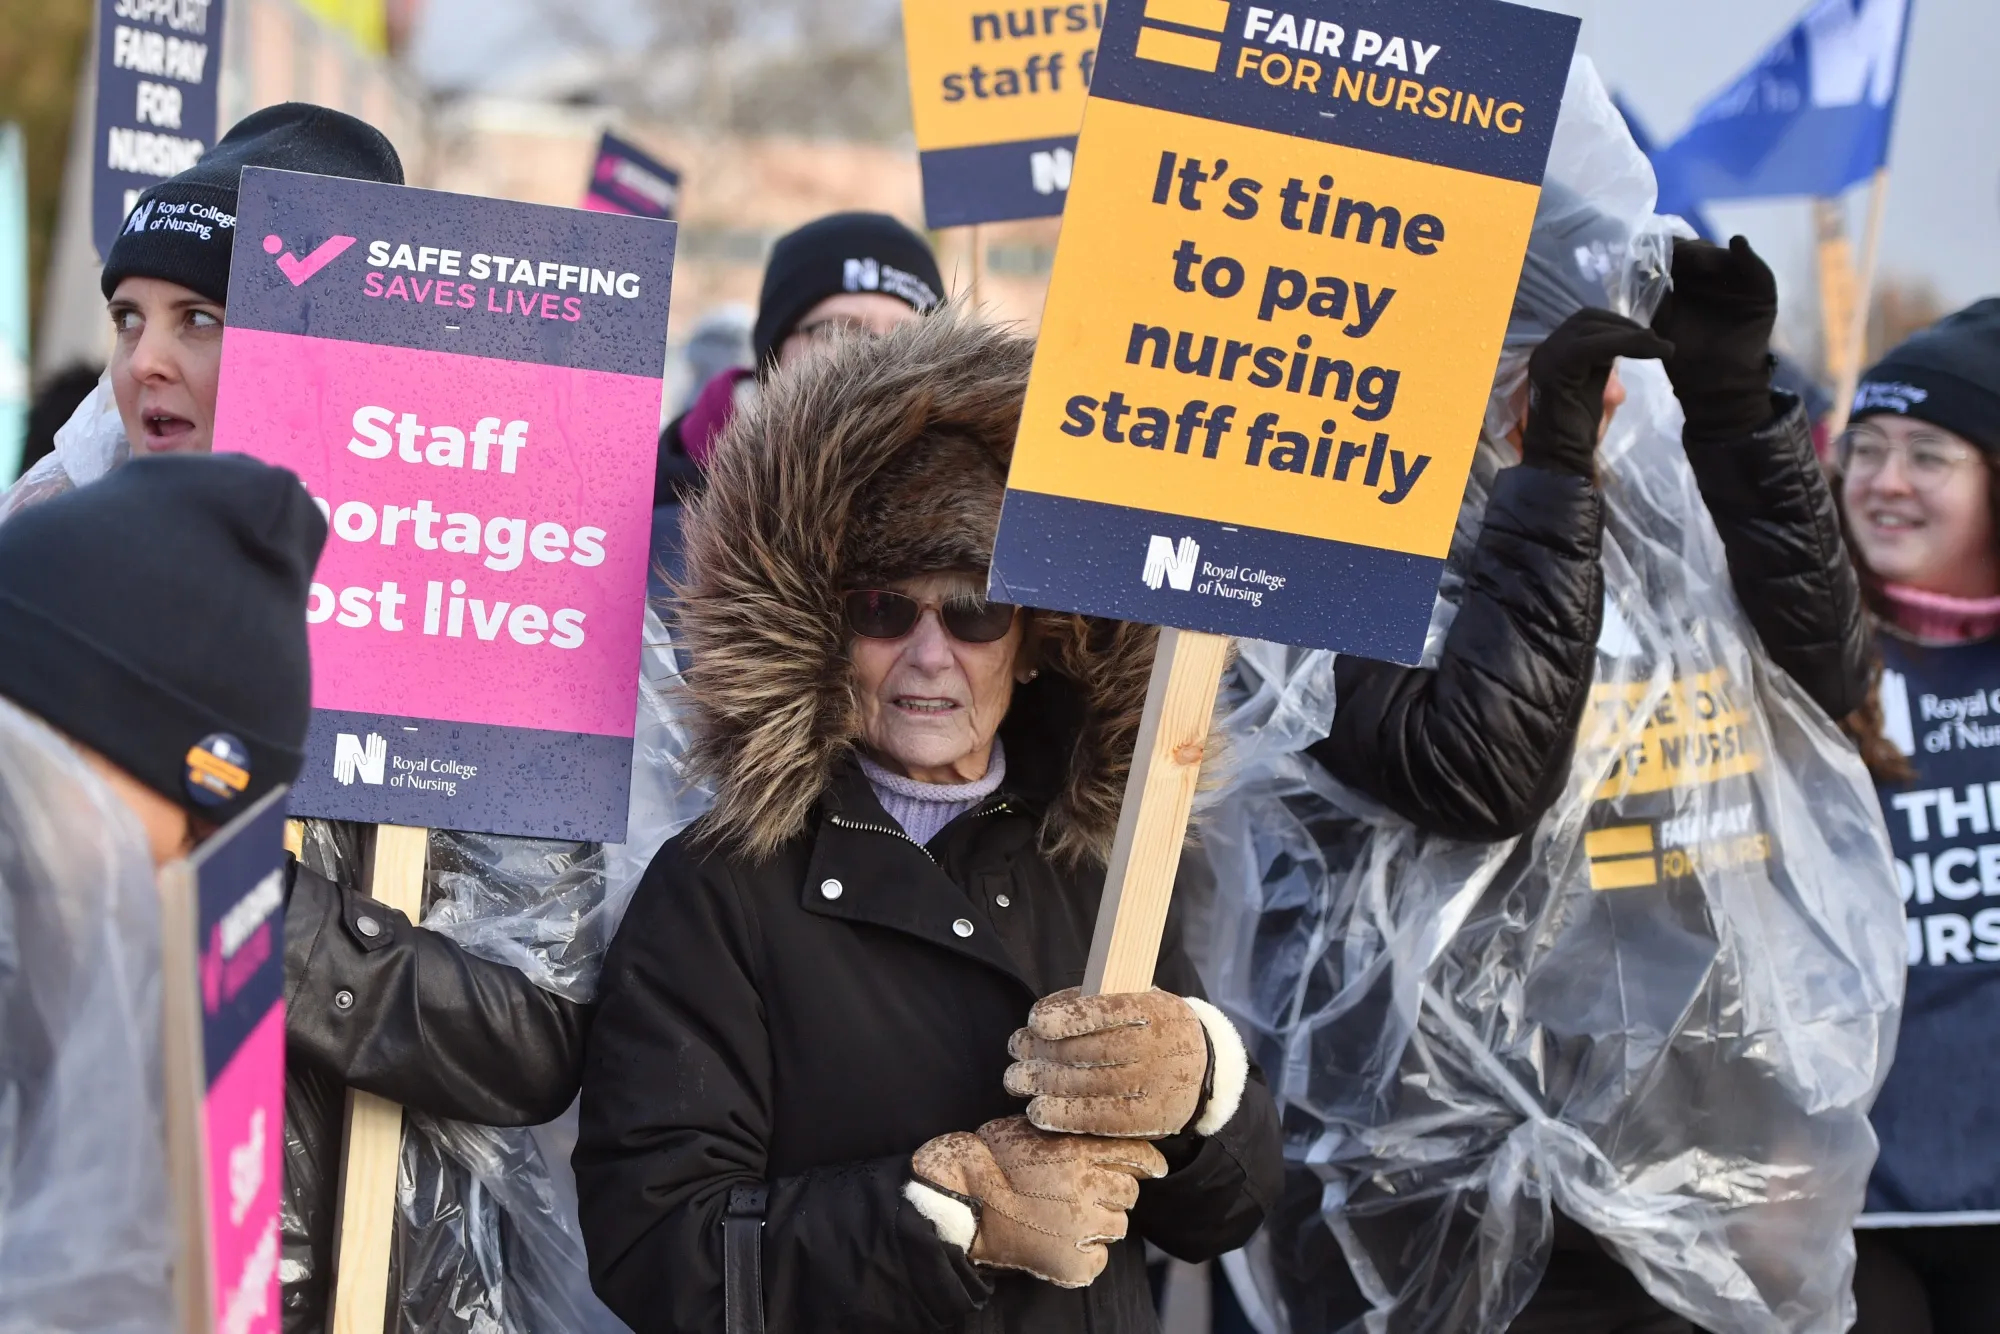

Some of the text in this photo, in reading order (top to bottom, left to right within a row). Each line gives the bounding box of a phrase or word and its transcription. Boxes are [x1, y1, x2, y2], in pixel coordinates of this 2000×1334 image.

[972, 3, 1103, 42] nursi
[1243, 6, 1441, 75] FAIR PAY
[113, 25, 208, 84] FAIR PAY
[942, 52, 1064, 102] staff
[136, 80, 183, 129] FOR
[1235, 47, 1525, 134] FOR NURSING
[149, 216, 213, 240] of Nursing
[156, 201, 190, 216] Royal
[189, 203, 237, 228] College
[1280, 175, 1445, 256] time
[366, 240, 641, 300] SAFE STAFFING
[1172, 240, 1397, 338] to pay
[363, 272, 581, 322] SAVES LIVES
[1125, 323, 1401, 421] nursing
[346, 405, 530, 474] Staff
[1060, 391, 1431, 505] staff fairly
[300, 482, 607, 571] ortages
[1197, 580, 1264, 607] of Nursing
[1202, 561, 1287, 591] Royal College
[305, 579, 587, 649] ost lives
[1919, 688, 1987, 722] Royal
[1660, 725, 1745, 770] NURSI
[1923, 720, 1952, 753] of
[390, 774, 457, 796] of Nursing
[393, 756, 478, 780] Royal College
